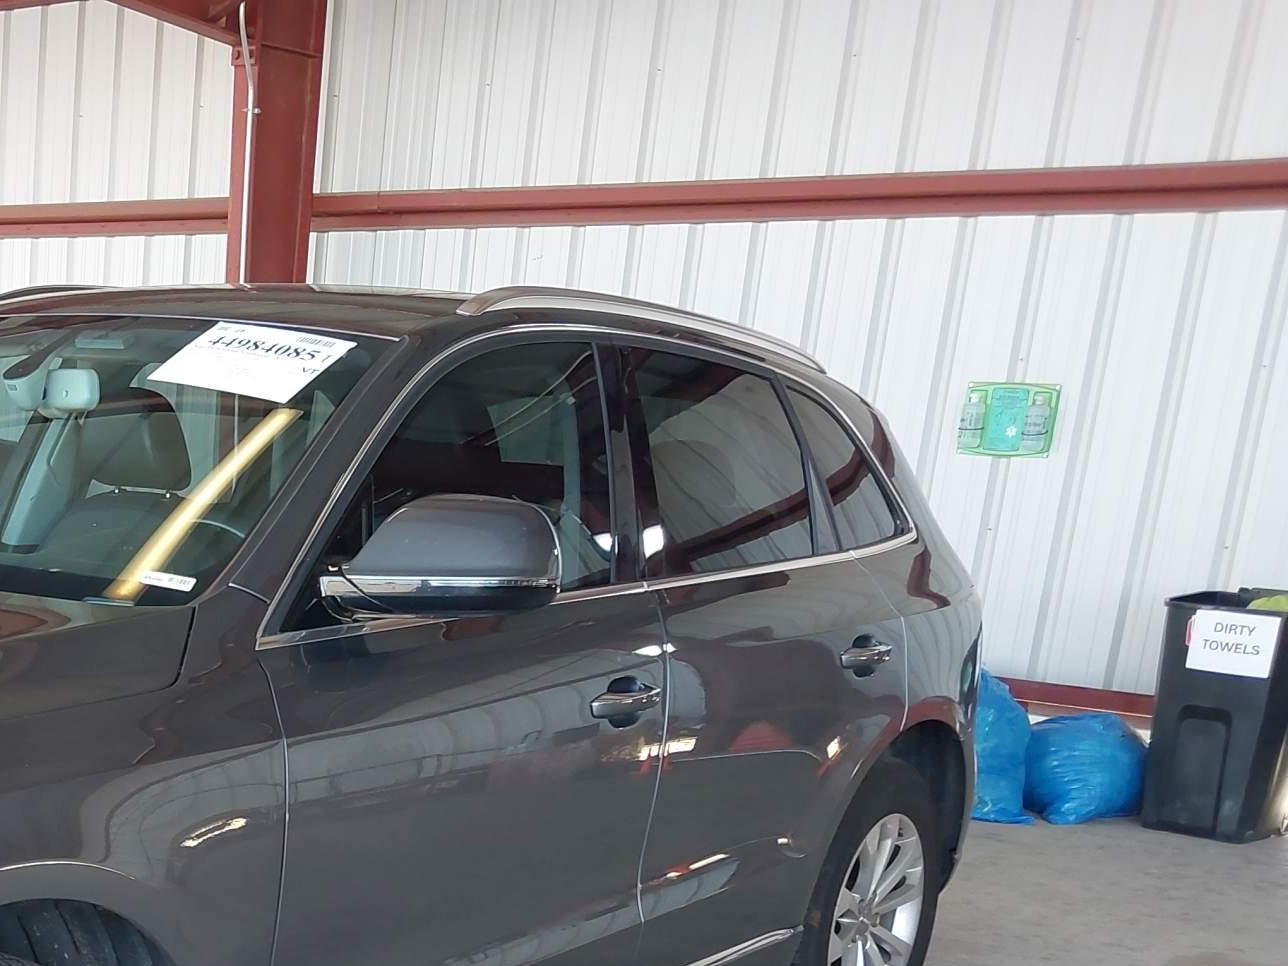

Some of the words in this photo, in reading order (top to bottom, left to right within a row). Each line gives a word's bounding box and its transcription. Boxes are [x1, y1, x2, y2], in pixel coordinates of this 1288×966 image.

[208, 336, 321, 360] 44984085
[1213, 621, 1257, 637] DIRTY
[1202, 638, 1261, 656] TOWELS
